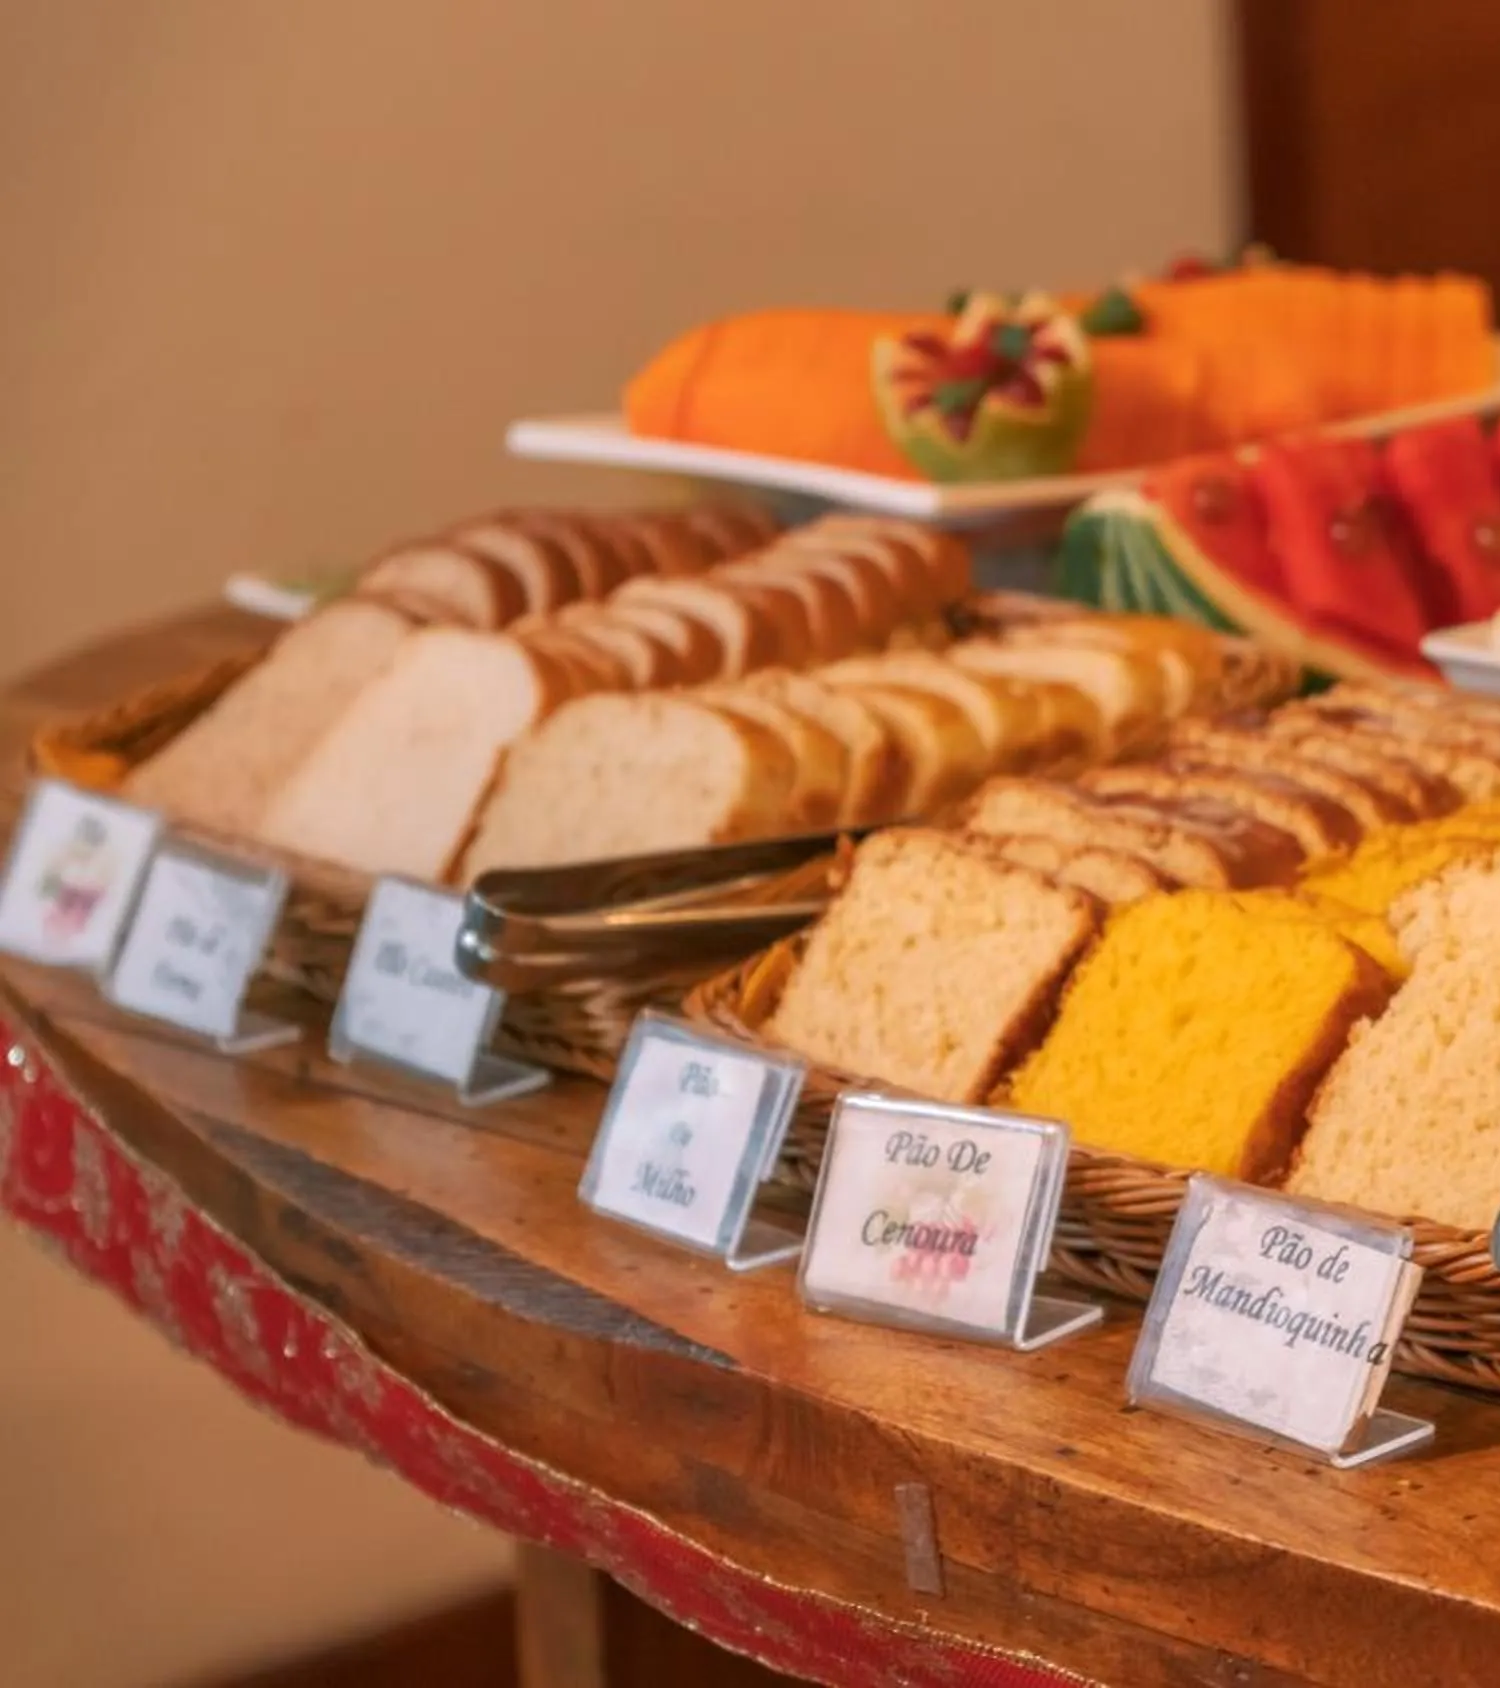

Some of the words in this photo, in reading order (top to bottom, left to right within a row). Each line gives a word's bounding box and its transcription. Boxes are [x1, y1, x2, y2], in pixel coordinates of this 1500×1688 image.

[885, 1130, 941, 1168] Pão
[946, 1139, 992, 1175] De
[860, 1209, 980, 1258] Cenoura
[1259, 1224, 1313, 1271] Pão
[1316, 1244, 1351, 1284] de
[1183, 1264, 1389, 1366] Mandioquinha
